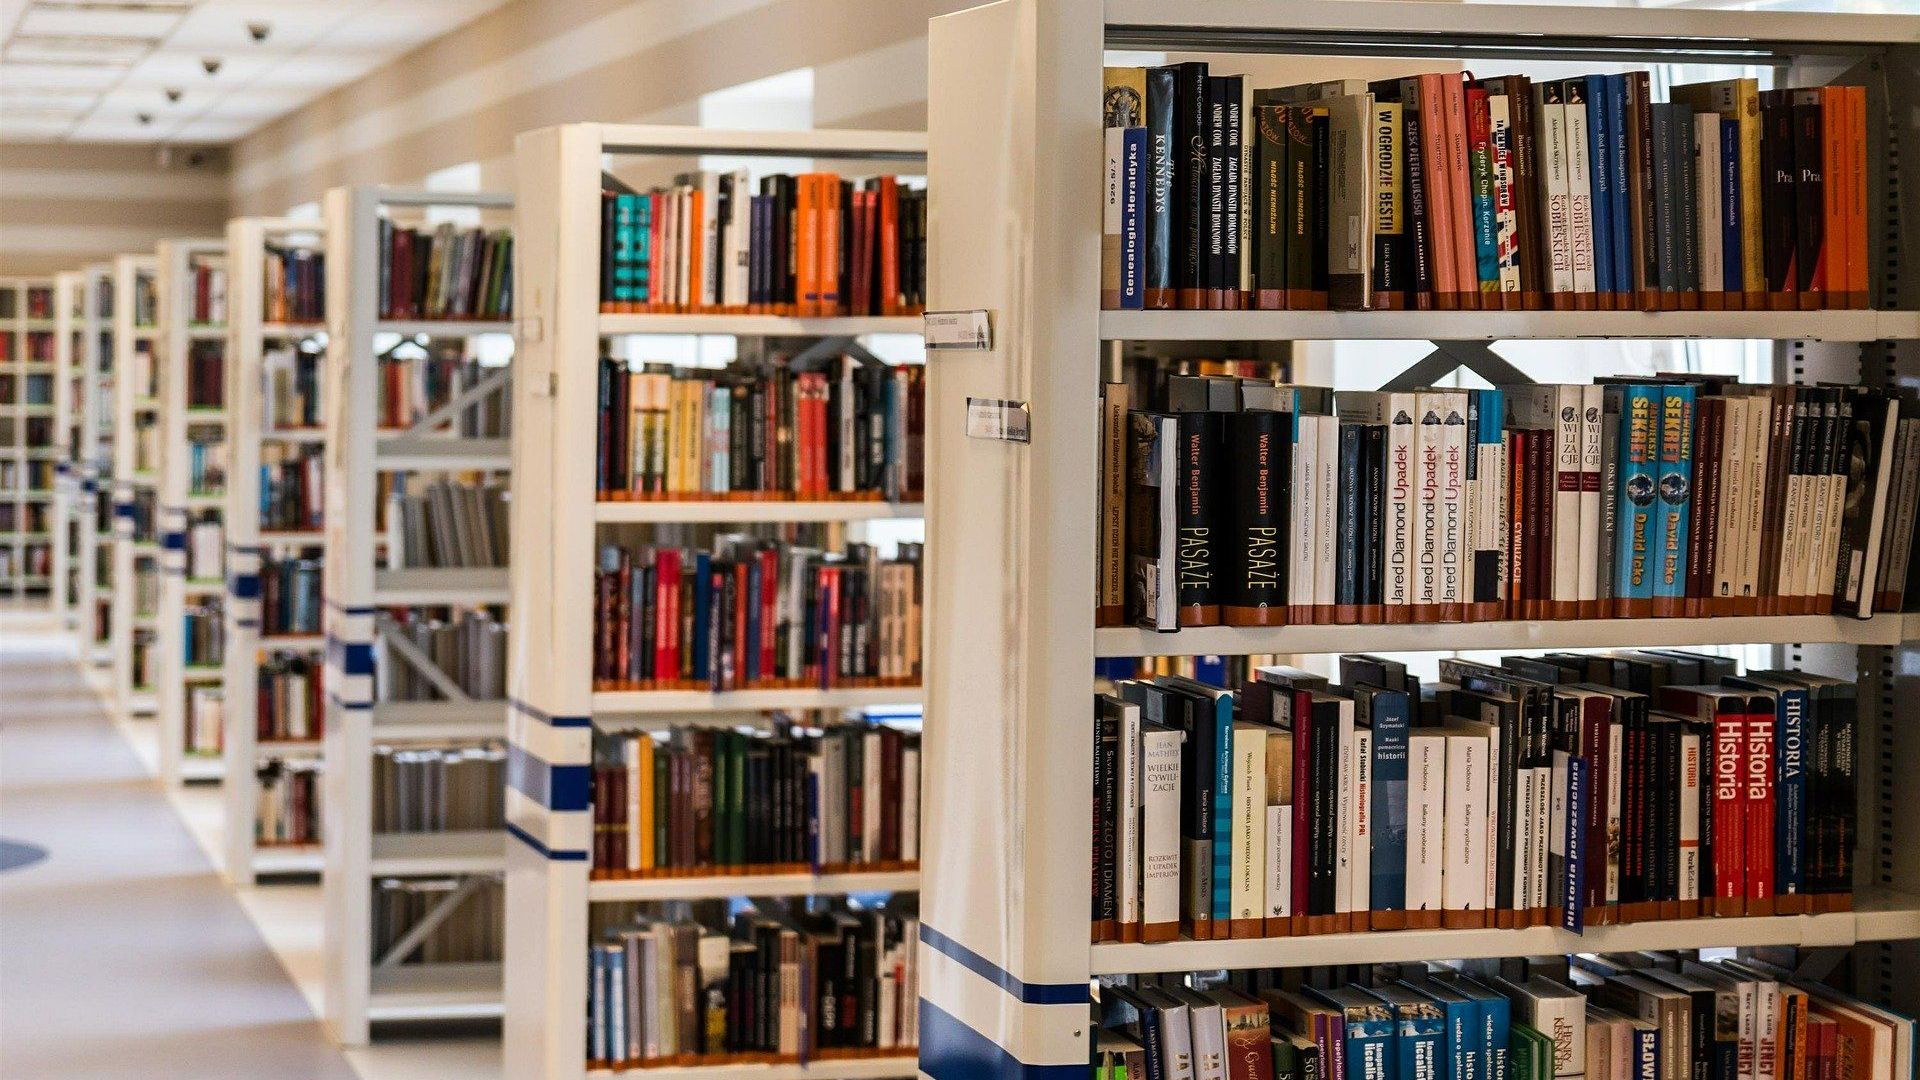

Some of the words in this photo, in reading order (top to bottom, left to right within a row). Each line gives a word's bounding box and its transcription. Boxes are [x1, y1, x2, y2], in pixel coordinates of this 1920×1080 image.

[1213, 103, 1222, 128] ANDREW
[1229, 103, 1238, 128] ANDREW
[1379, 110, 1393, 122] W
[1213, 130, 1222, 147] COOK
[1229, 130, 1238, 147] COOK
[1379, 126, 1393, 187] OGRODZIE
[1496, 120, 1507, 159] TAJEMNICE
[1155, 134, 1166, 213] KENNEDYS
[1212, 157, 1222, 183] ZAGŁADA
[1228, 157, 1238, 183] ZAGŁADA
[1269, 160, 1277, 187] MIŁOŚĆ
[1477, 142, 1488, 177] Fryderyk
[1212, 185, 1222, 212] DYNASTII
[1228, 185, 1238, 212] DYNASTII
[1411, 179, 1423, 216] LUKSUSU
[1498, 163, 1509, 205] WINDSORÓW
[1126, 143, 1138, 296] Genealogia.Heraldyka
[1269, 189, 1277, 235] NIEMOŻLIWA
[1379, 192, 1393, 230] BESTII
[1482, 211, 1492, 246] Korzenie
[1212, 214, 1222, 255] ROMANOWÓW
[1228, 214, 1238, 255] ROMANOWÓW
[1551, 194, 1564, 272] SOBIESKICH
[1573, 194, 1586, 272] SOBIESKICH
[1630, 396, 1649, 464] SEKRET
[1662, 396, 1682, 464] SEKRET
[1191, 434, 1201, 465] Walter
[1259, 434, 1269, 465] Walter
[1393, 444, 1409, 501] Upadek
[1422, 445, 1439, 501] Upadek
[1445, 445, 1461, 501] Upadek
[1607, 463, 1615, 491] OSKAR
[1732, 460, 1740, 486] Historia
[1755, 462, 1763, 488] Historia
[1804, 476, 1813, 501] OBLICZA
[1834, 476, 1843, 501] OBLICZA
[1189, 469, 1201, 515] Benjamin
[1257, 469, 1269, 515] Benjamin
[1790, 476, 1799, 508] GRANICE
[1818, 476, 1828, 508] GRANICE
[1605, 495, 1615, 532] HALECKI
[1665, 512, 1680, 549] David
[1786, 509, 1796, 541] HISTORII
[1801, 501, 1810, 528] HISTORII
[1814, 509, 1825, 541] HISTORII
[1831, 501, 1840, 528] HISTORII
[1391, 502, 1406, 564] Diamond
[1421, 502, 1435, 564] Diamond
[1443, 502, 1457, 564] Diamond
[1633, 513, 1647, 551] David
[1181, 527, 1214, 589] PASAŻE
[1248, 527, 1280, 589] PASAŻE
[1513, 522, 1522, 584] CYWILIZACJE
[1632, 555, 1646, 586] Icke
[1664, 553, 1679, 584] Icke
[1391, 566, 1404, 606] Jared
[1420, 566, 1434, 606] Jared
[1443, 566, 1456, 604] Jared
[1360, 737, 1368, 754] Rafał
[1378, 751, 1406, 760] historii
[1786, 698, 1802, 778] HISTORIA
[1106, 750, 1114, 775] SILVIA
[1147, 763, 1180, 772] WIELKIE
[1148, 773, 1180, 782] CYWILI-
[1245, 752, 1253, 774] Wojciech
[1359, 755, 1368, 782] Stobiecki
[1687, 747, 1697, 788] HISTORIA
[1719, 721, 1743, 800] Historia
[1749, 721, 1773, 799] Historia
[1106, 777, 1114, 812] LIEBRICH
[1153, 783, 1176, 793] ZACJE
[1358, 783, 1367, 823] Historiografia
[1539, 774, 1547, 815] PRZESZŁOŚĆ
[1420, 803, 1429, 827] Bałkany
[1463, 803, 1472, 827] Bałkany
[1568, 762, 1579, 859] powszechna
[1104, 820, 1114, 859] ZŁOTO
[1420, 827, 1428, 864] wyobrażone
[1463, 827, 1471, 864] wyobrażone
[1146, 870, 1180, 879] IMPERIÓW
[1148, 854, 1178, 862] ROZKWIT
[1153, 863, 1178, 871] UPADEK
[1567, 864, 1577, 927] Historia
[1486, 1014, 1494, 1040] wiedza
[1553, 1017, 1565, 1071] KISSINGER
[1563, 1024, 1573, 1063] HENRY
[1304, 1057, 1315, 1073] 50
[1466, 1051, 1476, 1080] histo
